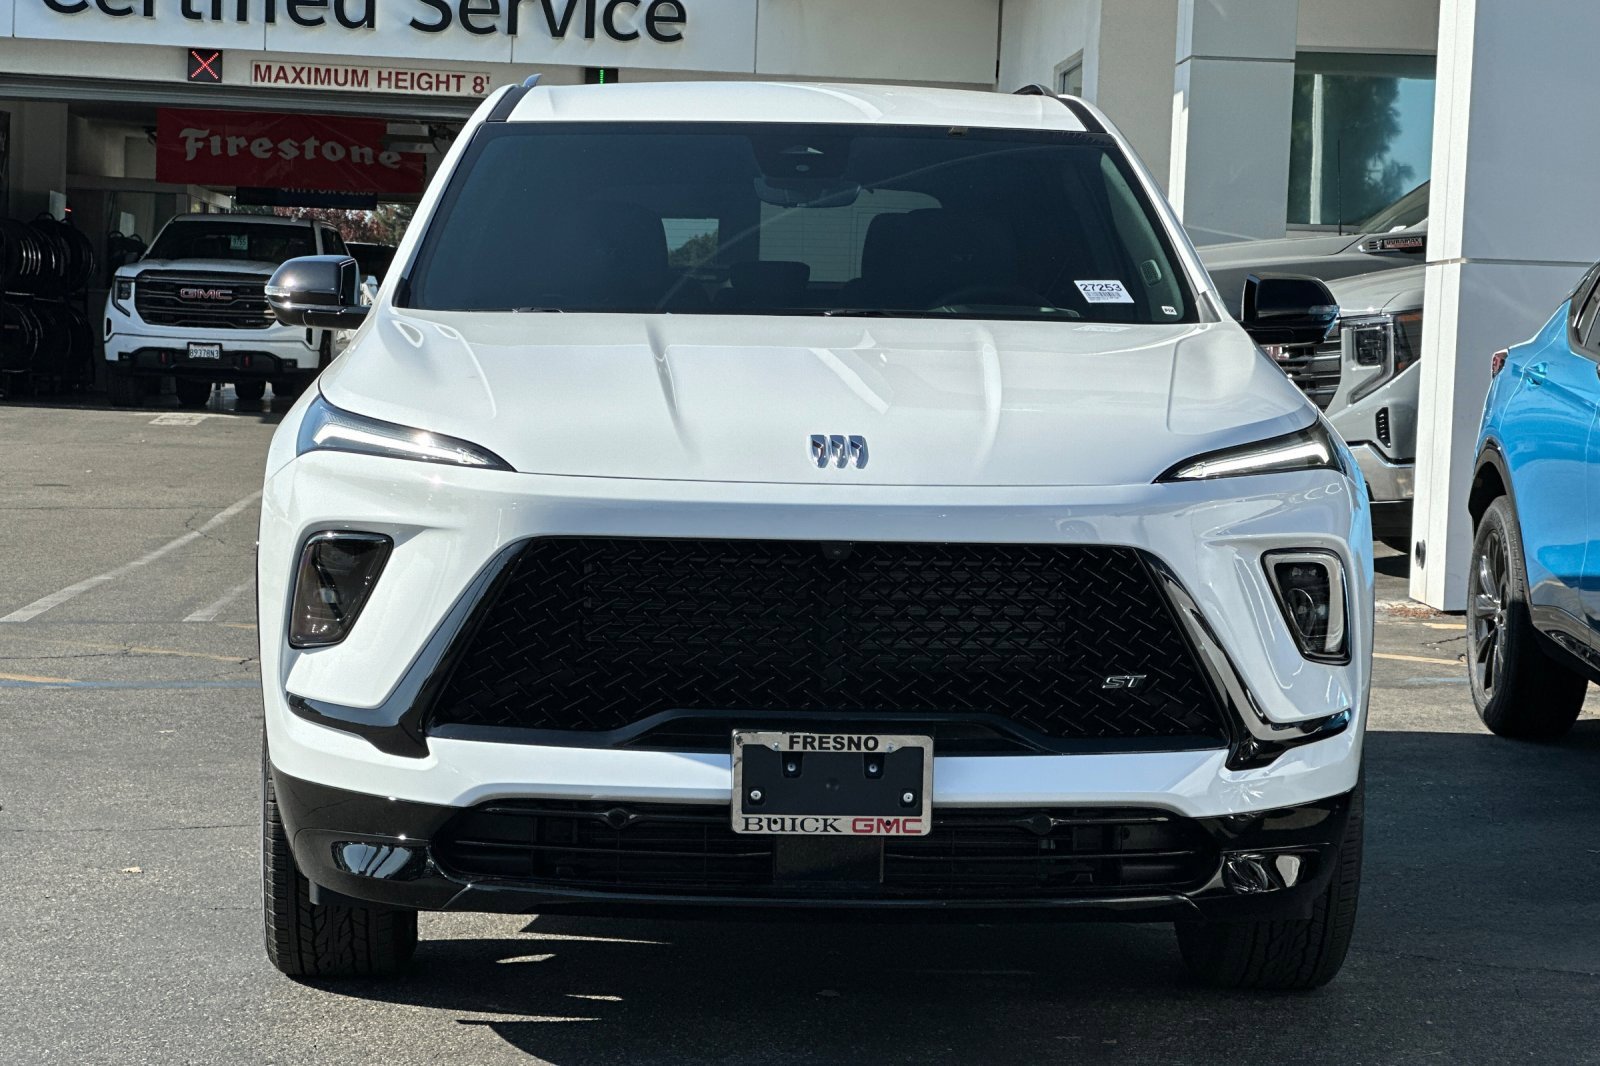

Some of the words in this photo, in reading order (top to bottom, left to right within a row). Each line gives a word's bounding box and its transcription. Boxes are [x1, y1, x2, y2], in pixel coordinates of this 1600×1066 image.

[409, 0, 687, 43] Service
[254, 64, 369, 88] MAXIMUM
[377, 70, 466, 93] HEIGHT
[179, 127, 402, 169] Firestone
[180, 288, 233, 299] GMC
[1079, 283, 1123, 292] 27253
[1101, 674, 1147, 689] ST
[788, 734, 879, 752] FRESNO
[851, 817, 922, 834] GMC
